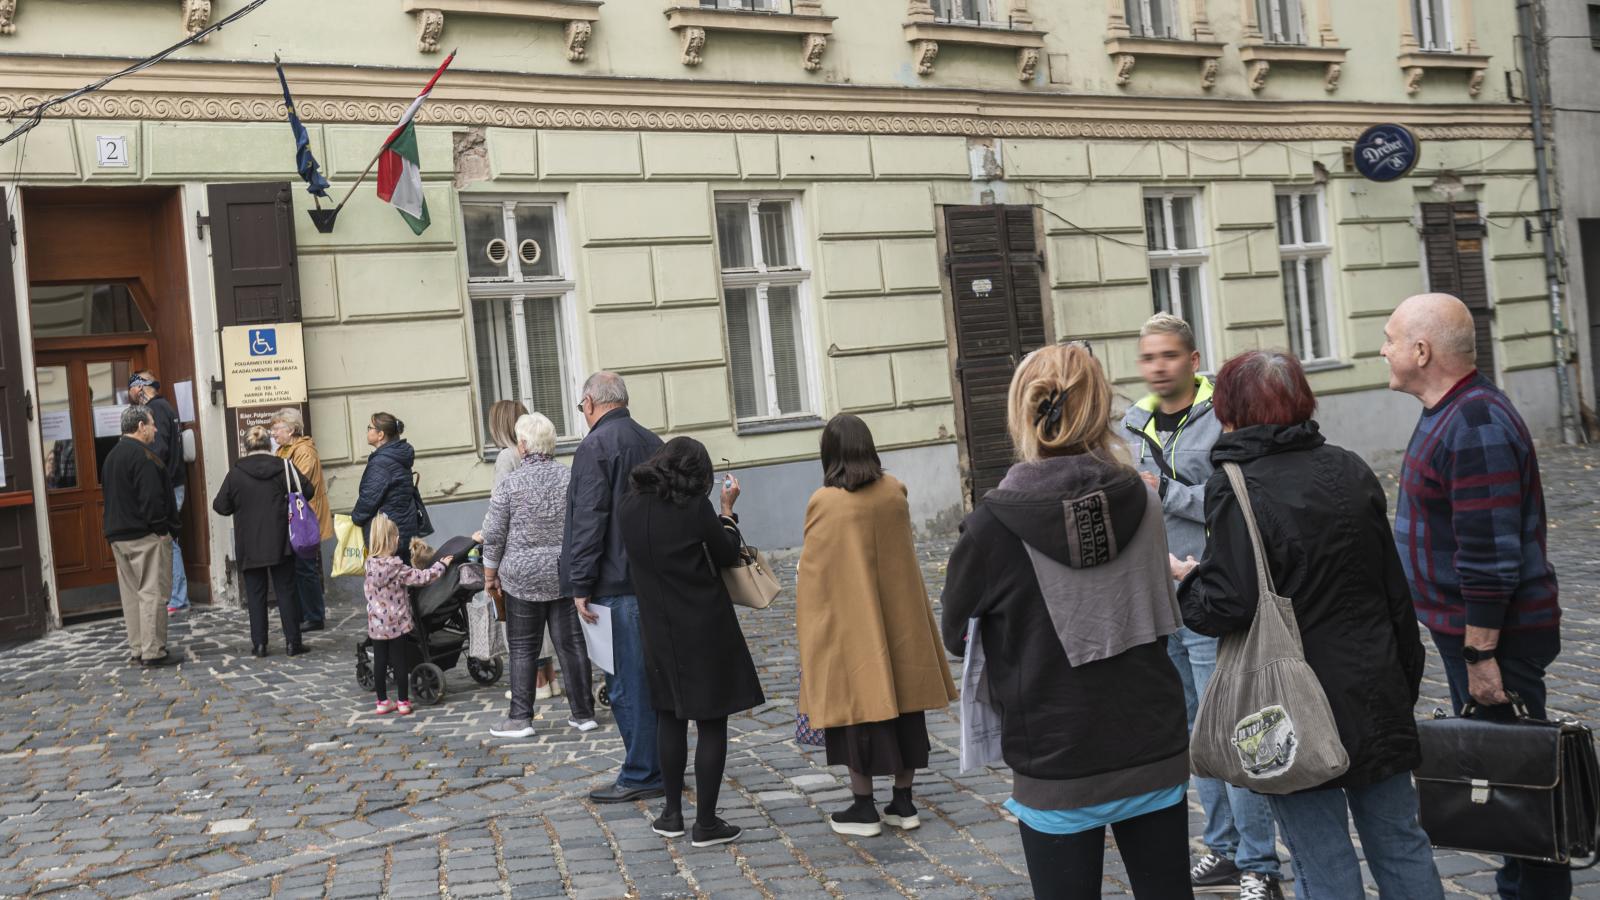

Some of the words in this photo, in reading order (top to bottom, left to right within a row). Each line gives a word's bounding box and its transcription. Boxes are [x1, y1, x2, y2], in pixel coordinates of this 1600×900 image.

[106, 141, 118, 159] 2
[1362, 140, 1404, 163] Dreher
[1079, 512, 1095, 568] SURFAC
